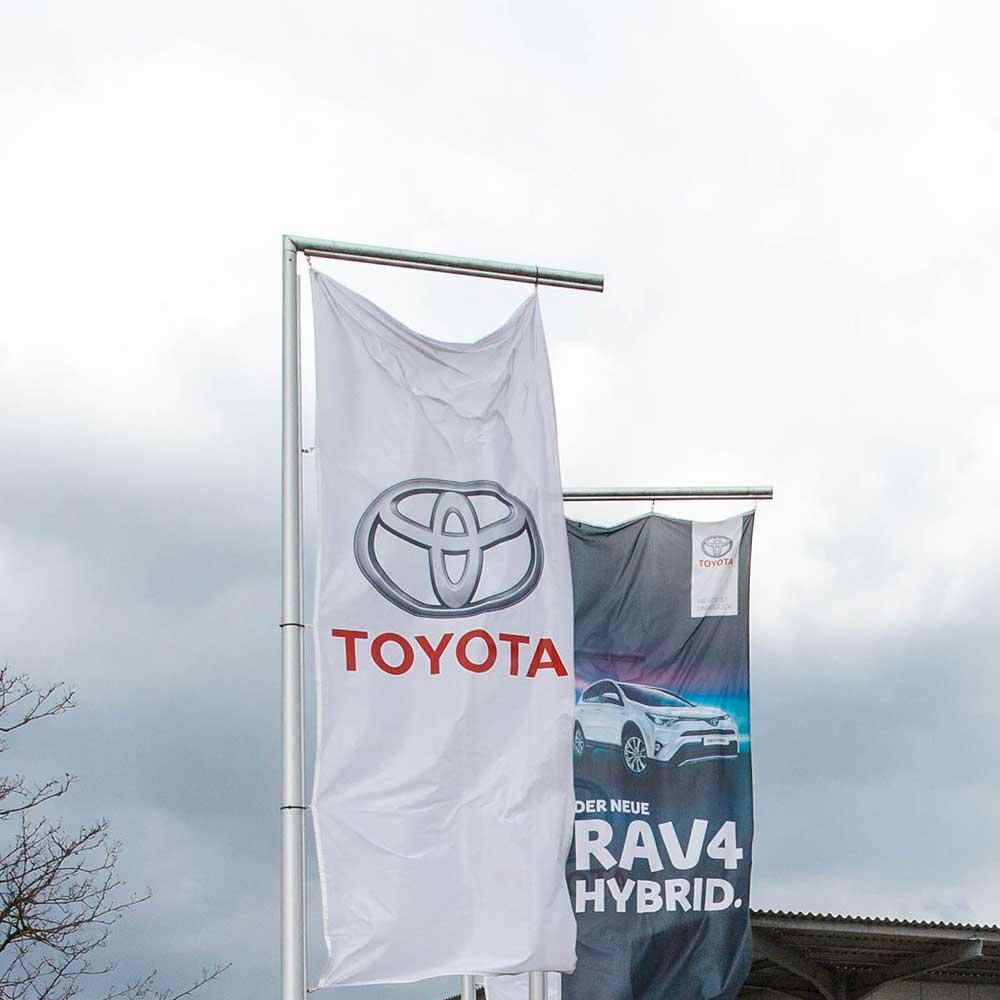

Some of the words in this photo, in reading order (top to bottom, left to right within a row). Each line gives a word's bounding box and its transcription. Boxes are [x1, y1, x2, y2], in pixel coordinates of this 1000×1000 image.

[699, 558, 734, 568] TOYOTA
[331, 629, 569, 678] TOYOTA
[576, 800, 607, 814] DER
[611, 800, 650, 815] NEUE
[575, 819, 744, 873] RAV4
[576, 878, 743, 914] HYBRID.
